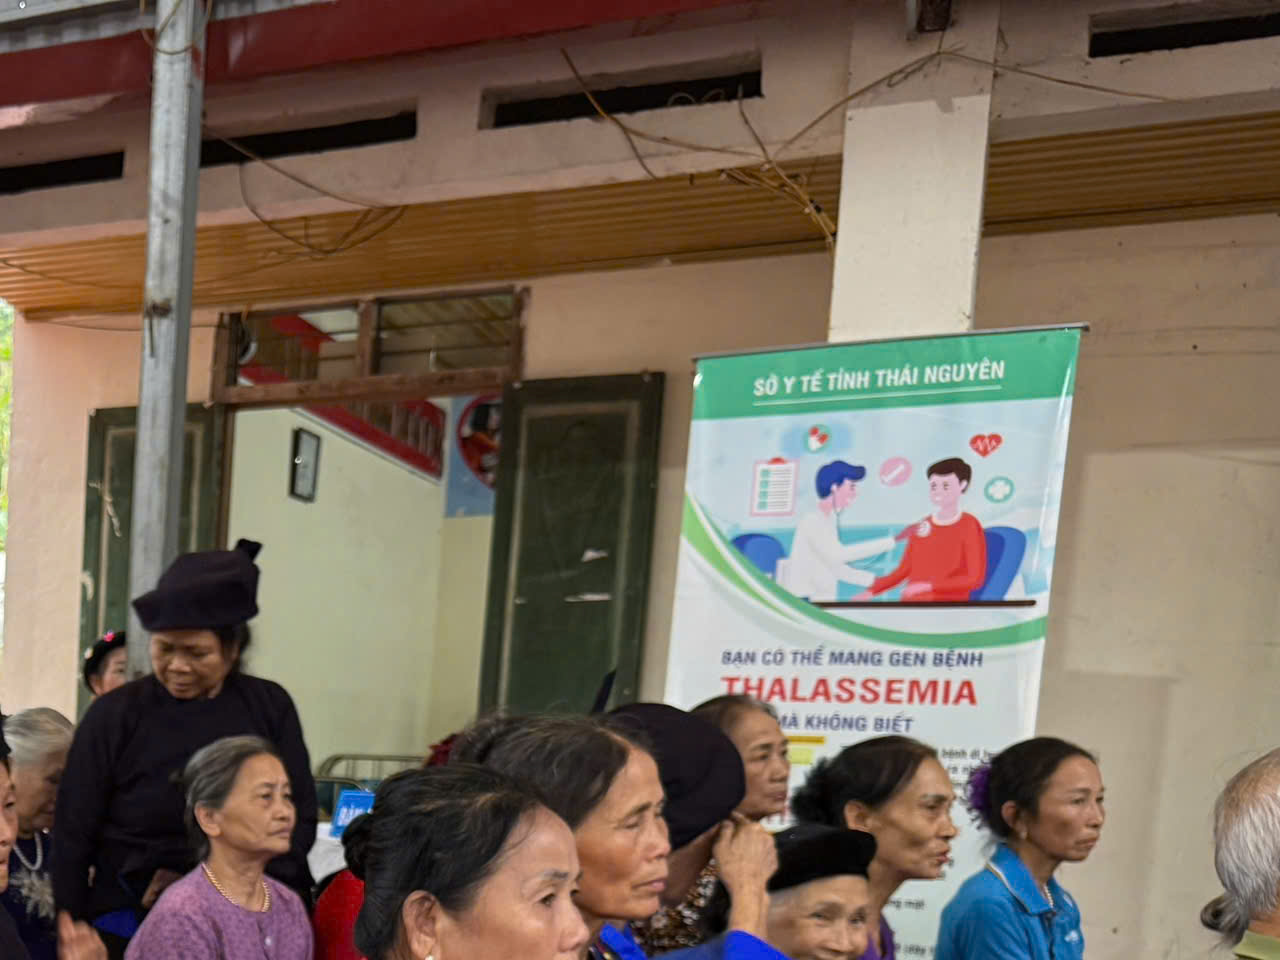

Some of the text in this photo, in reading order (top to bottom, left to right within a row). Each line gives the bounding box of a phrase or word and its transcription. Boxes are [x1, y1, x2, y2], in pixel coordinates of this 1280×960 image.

[783, 376, 796, 394] Y
[800, 368, 824, 393] TẾ
[874, 363, 918, 388] THÁI
[924, 356, 1006, 385] NGUYÊN
[721, 643, 984, 671] BẠN CÓ THỂ MANG GEN BỆNH
[721, 676, 979, 706] THALASSEMIA
[804, 713, 867, 732] KHÔNG
[873, 710, 915, 733] BIẾT
